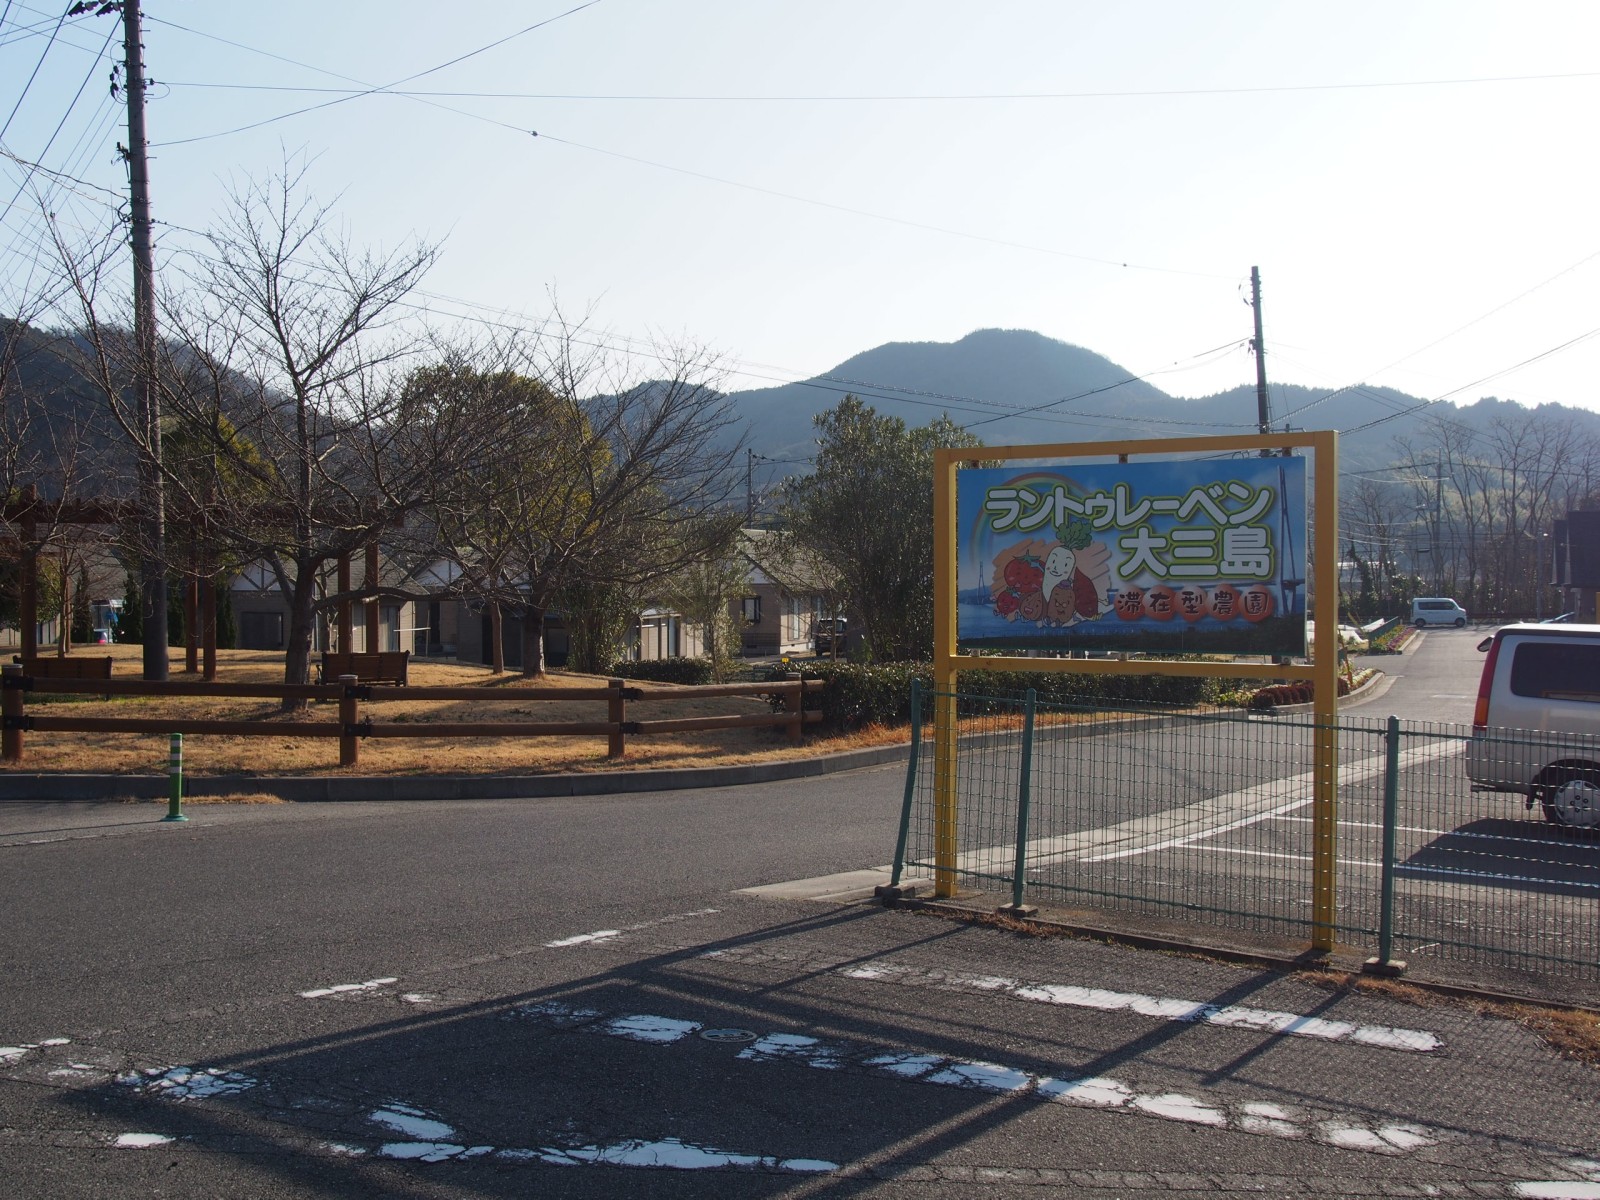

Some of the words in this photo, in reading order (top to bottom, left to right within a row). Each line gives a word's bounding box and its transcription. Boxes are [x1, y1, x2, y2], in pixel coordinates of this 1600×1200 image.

[985, 482, 1272, 530] ラントゥレーベン
[1119, 526, 1272, 578] 大三島
[1117, 590, 1269, 616] 滞在型農園
